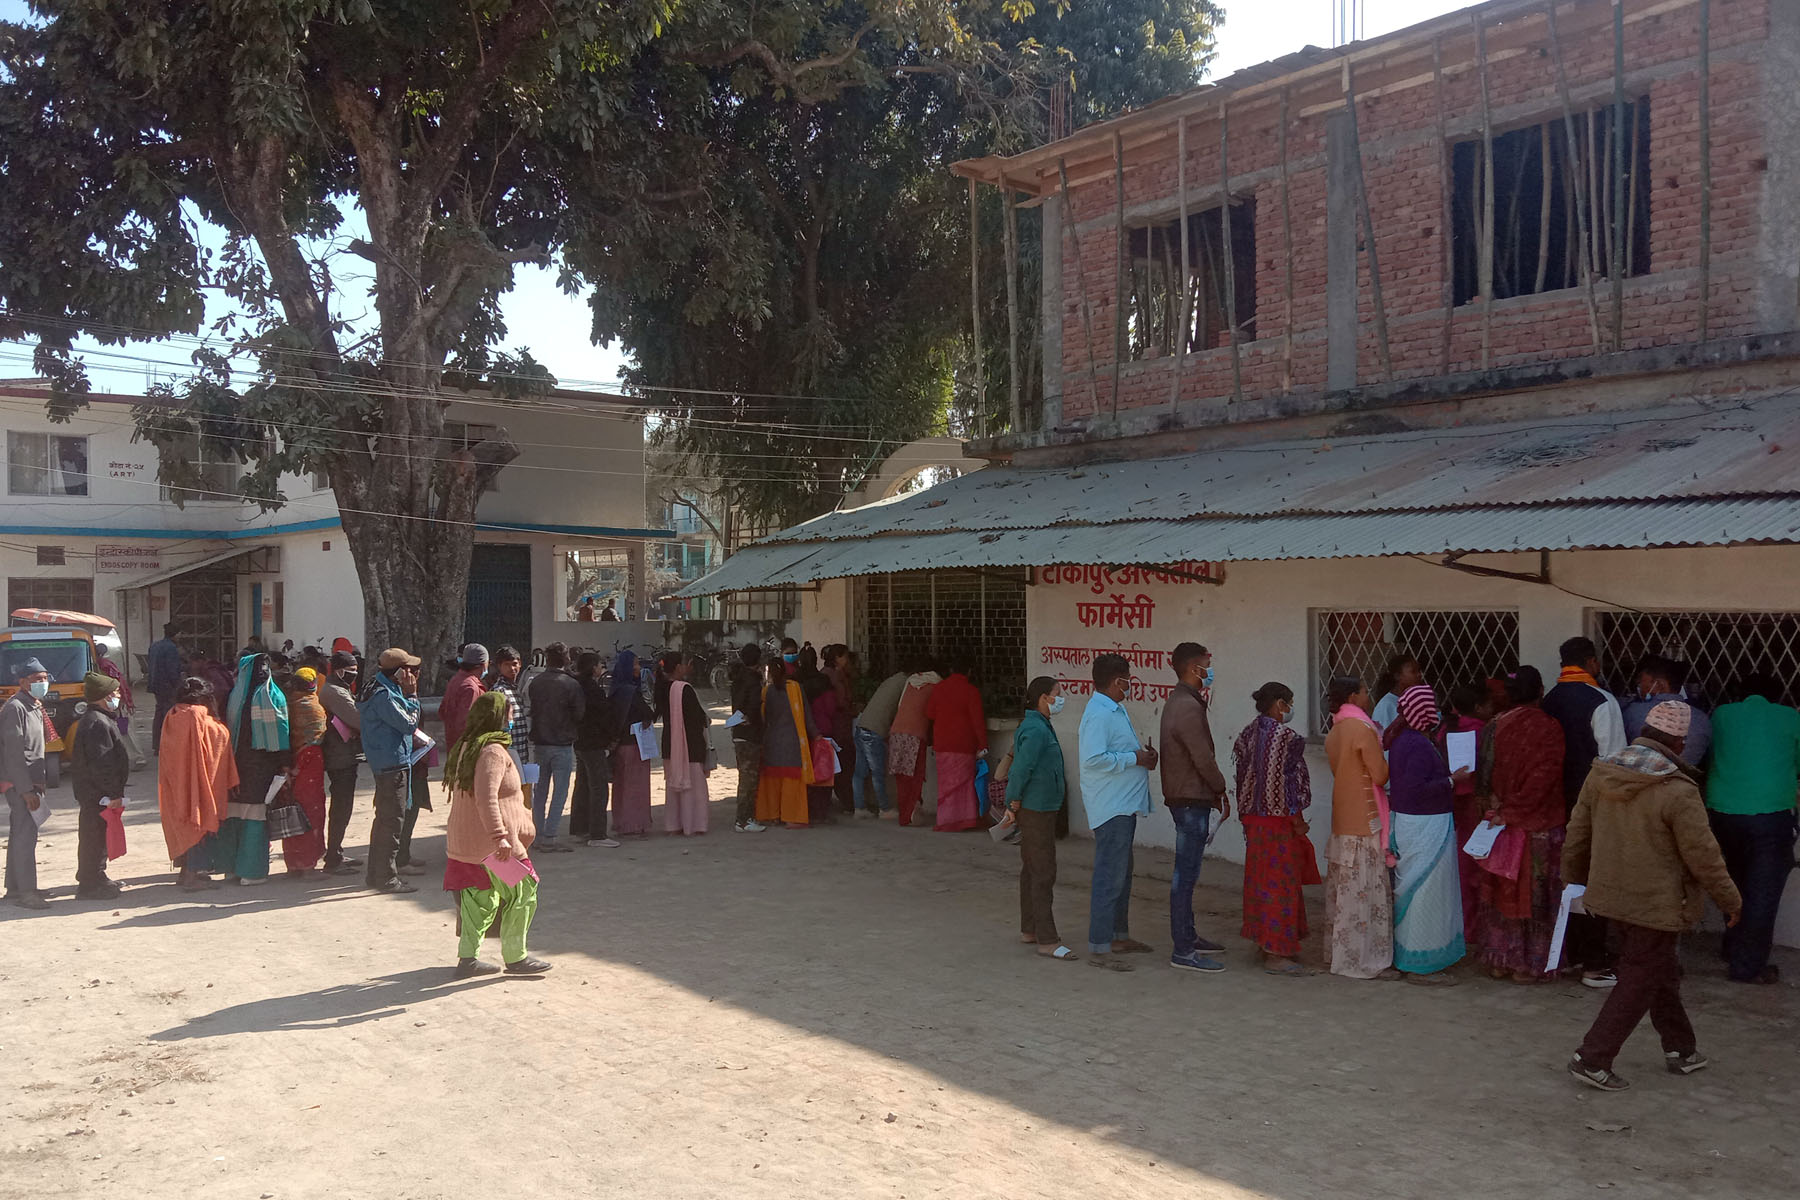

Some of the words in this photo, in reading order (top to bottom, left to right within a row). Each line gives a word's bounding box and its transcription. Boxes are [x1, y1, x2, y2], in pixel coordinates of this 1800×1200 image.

[101, 561, 137, 569] ENDOSCOPY
[141, 561, 160, 569] ROOM
[1076, 594, 1155, 629] फार्मेसी
[1040, 646, 1090, 668] अस्पताल
